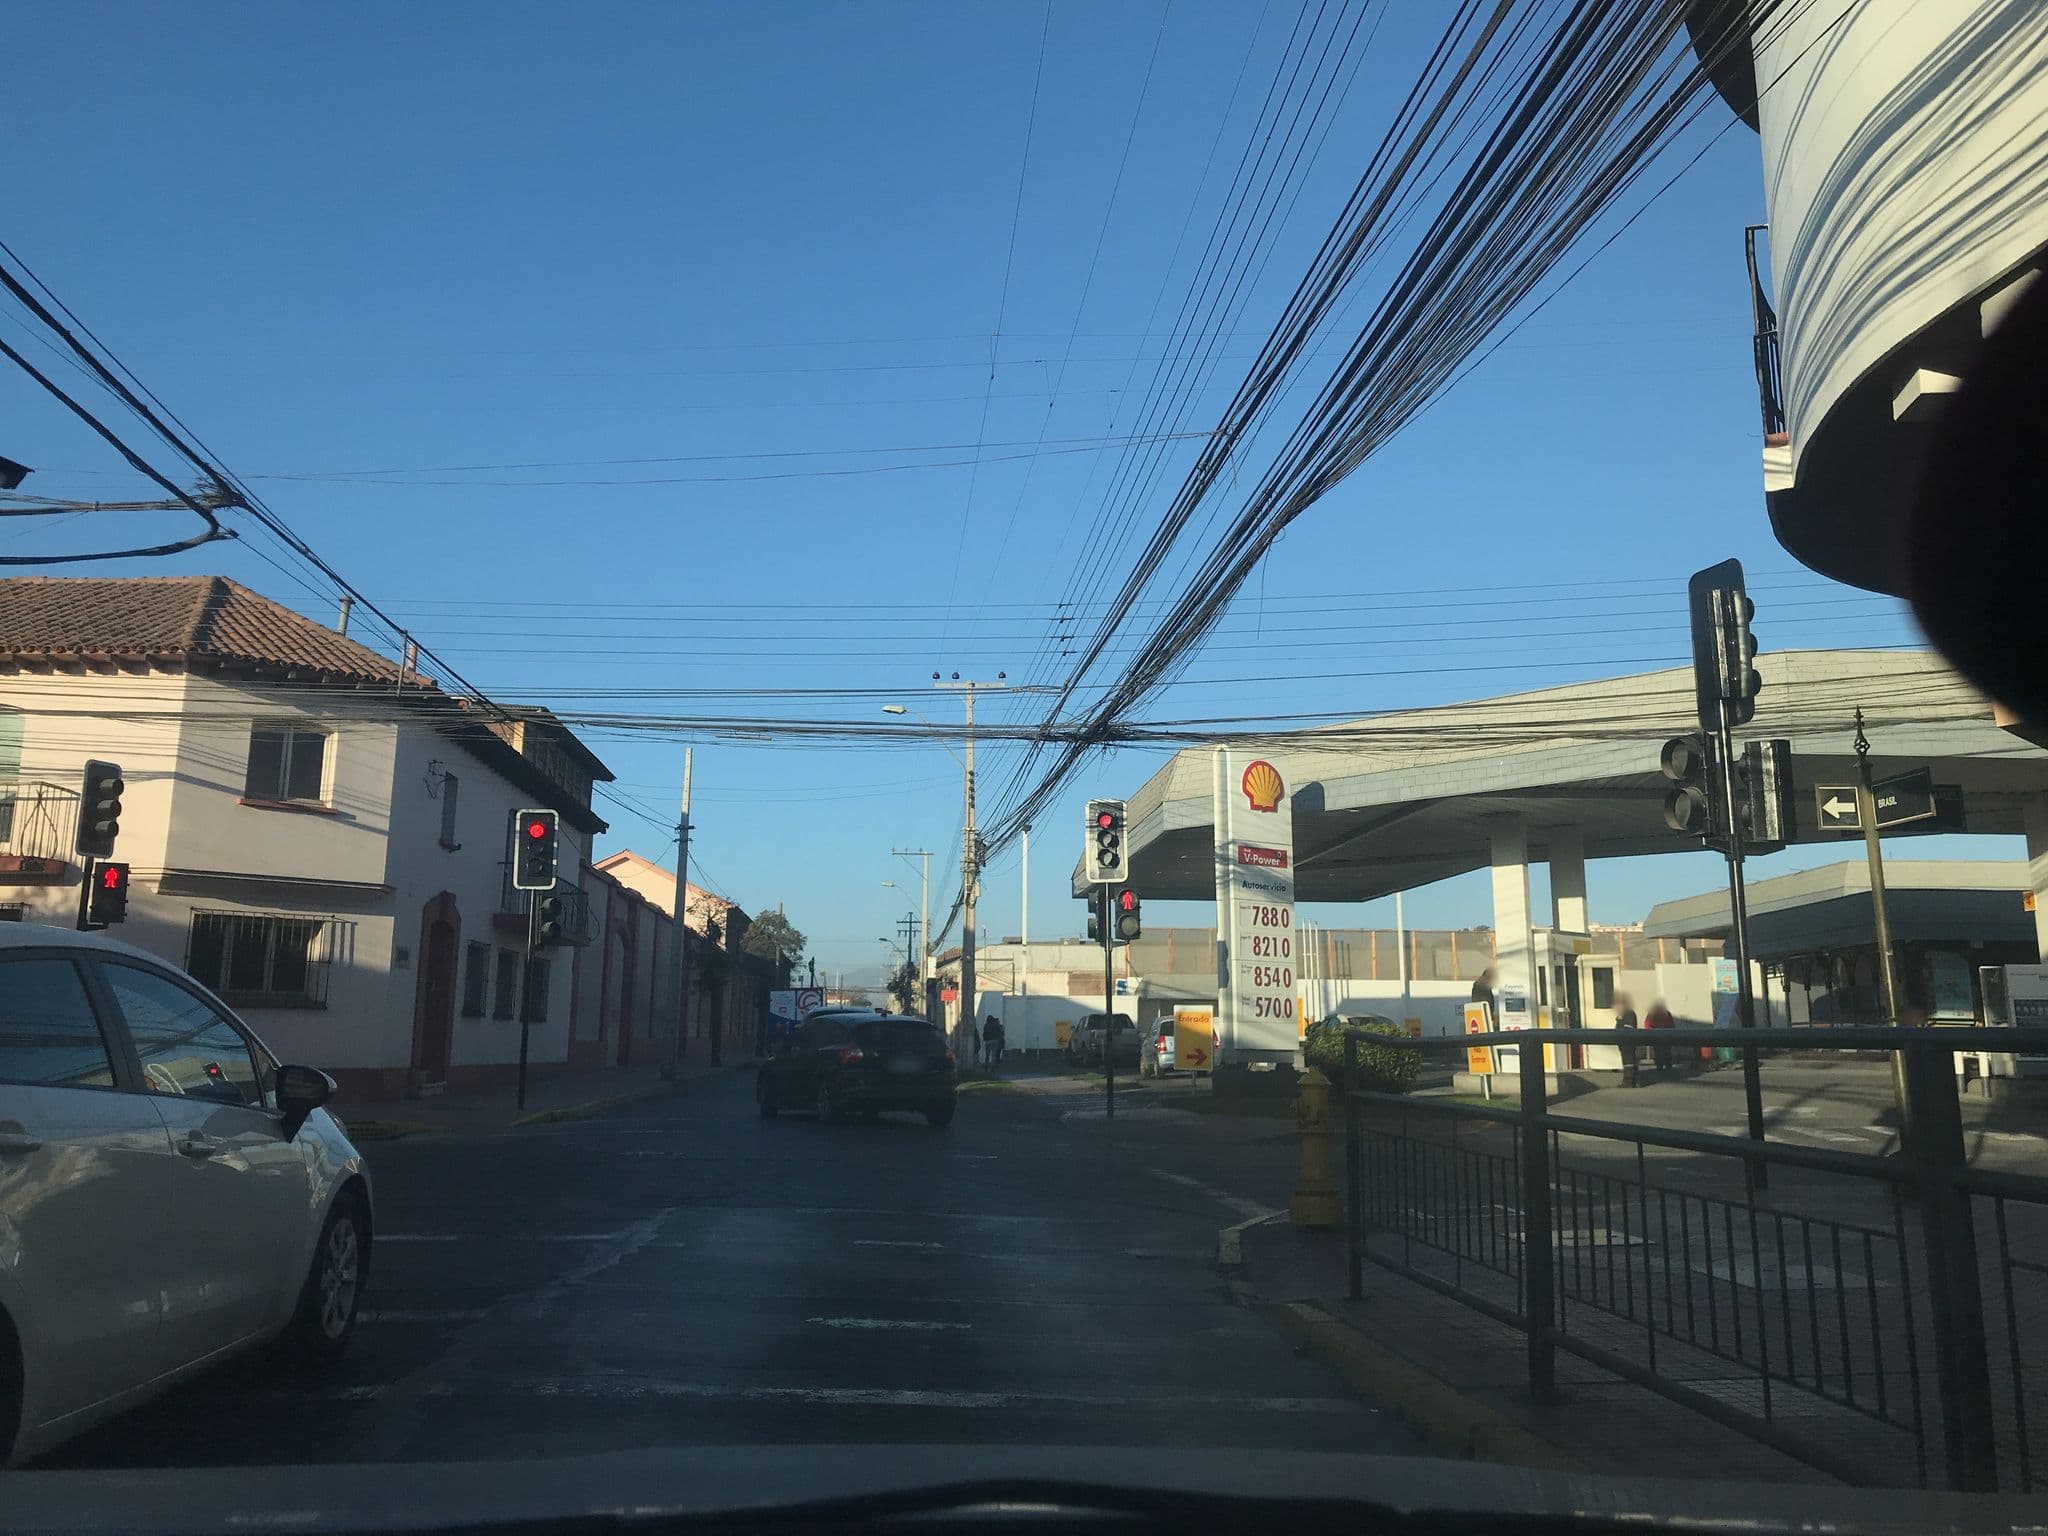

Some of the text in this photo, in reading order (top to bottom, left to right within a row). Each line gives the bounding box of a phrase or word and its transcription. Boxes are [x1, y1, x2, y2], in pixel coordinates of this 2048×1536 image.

[1878, 796, 1898, 808] BRASIL
[1242, 881, 1287, 892] Autoservicio
[1178, 1014, 1209, 1023] Entrada
